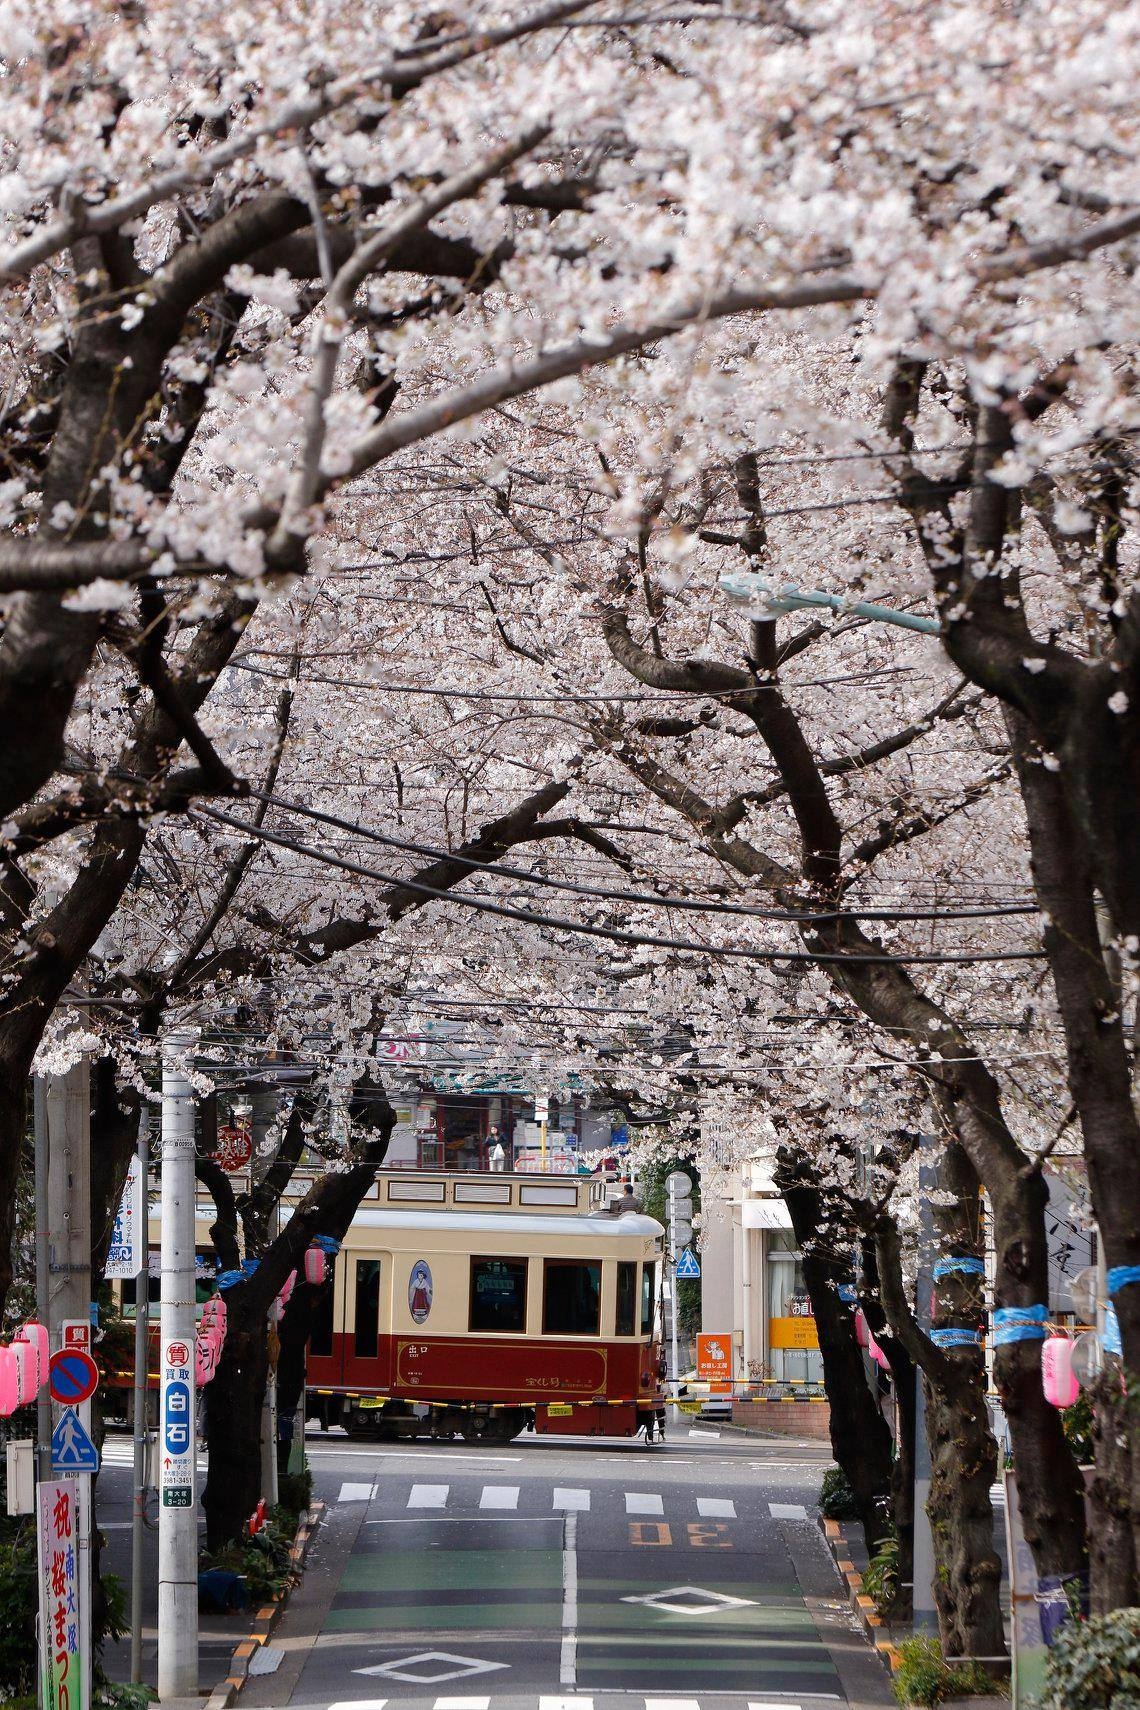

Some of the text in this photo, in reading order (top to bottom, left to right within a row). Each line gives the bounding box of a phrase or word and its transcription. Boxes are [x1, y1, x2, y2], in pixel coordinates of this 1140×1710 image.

[792, 1302, 815, 1315] お直し
[72, 1327, 86, 1342] 質
[169, 1346, 186, 1364] 質
[409, 1345, 428, 1355] 出口
[165, 1368, 190, 1381] 買取
[525, 1377, 561, 1388] 宝くじ号
[166, 1391, 187, 1443] 白石
[167, 1490, 187, 1498] 南大塚
[65, 1543, 77, 1654] 南大塚
